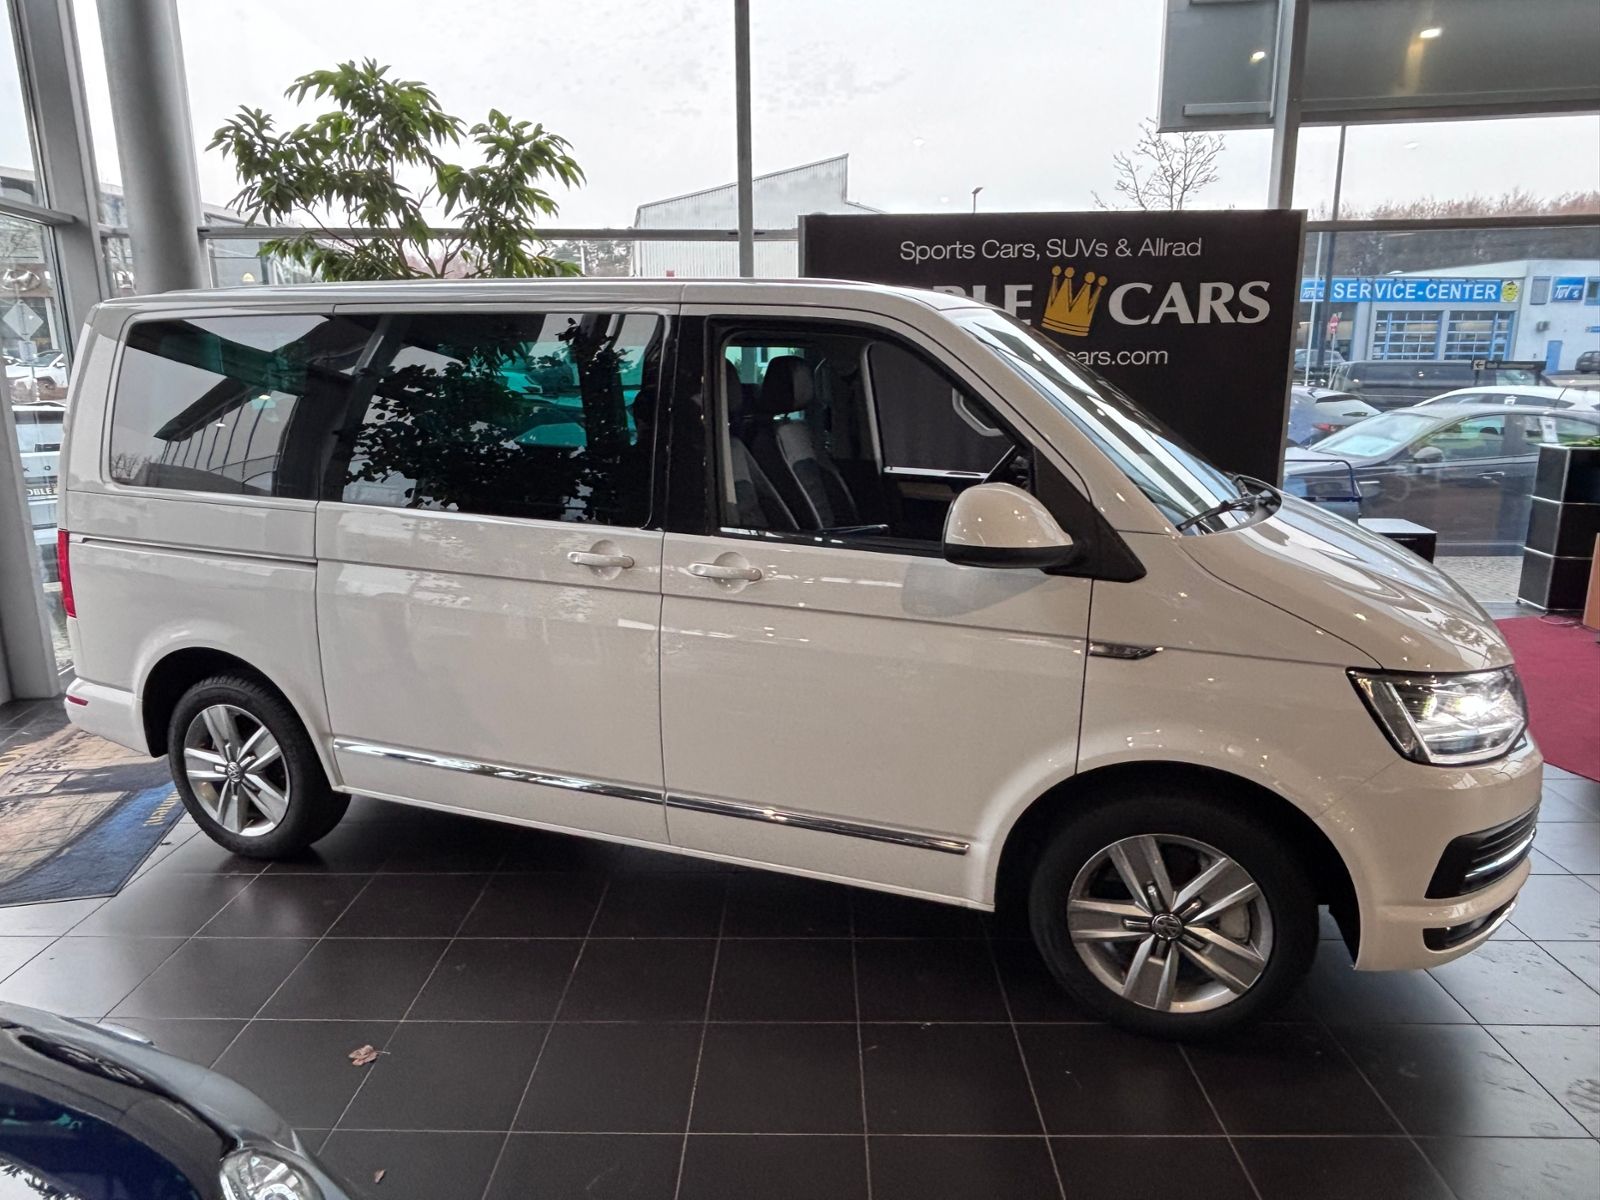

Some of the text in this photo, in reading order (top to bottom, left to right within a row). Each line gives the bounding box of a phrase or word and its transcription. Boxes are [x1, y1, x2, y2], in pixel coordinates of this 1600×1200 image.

[900, 237, 1202, 264] Sports Cars, SUVs & Allrad
[1108, 280, 1271, 326] CARS
[1333, 282, 1497, 299] SERVICE-CENTER
